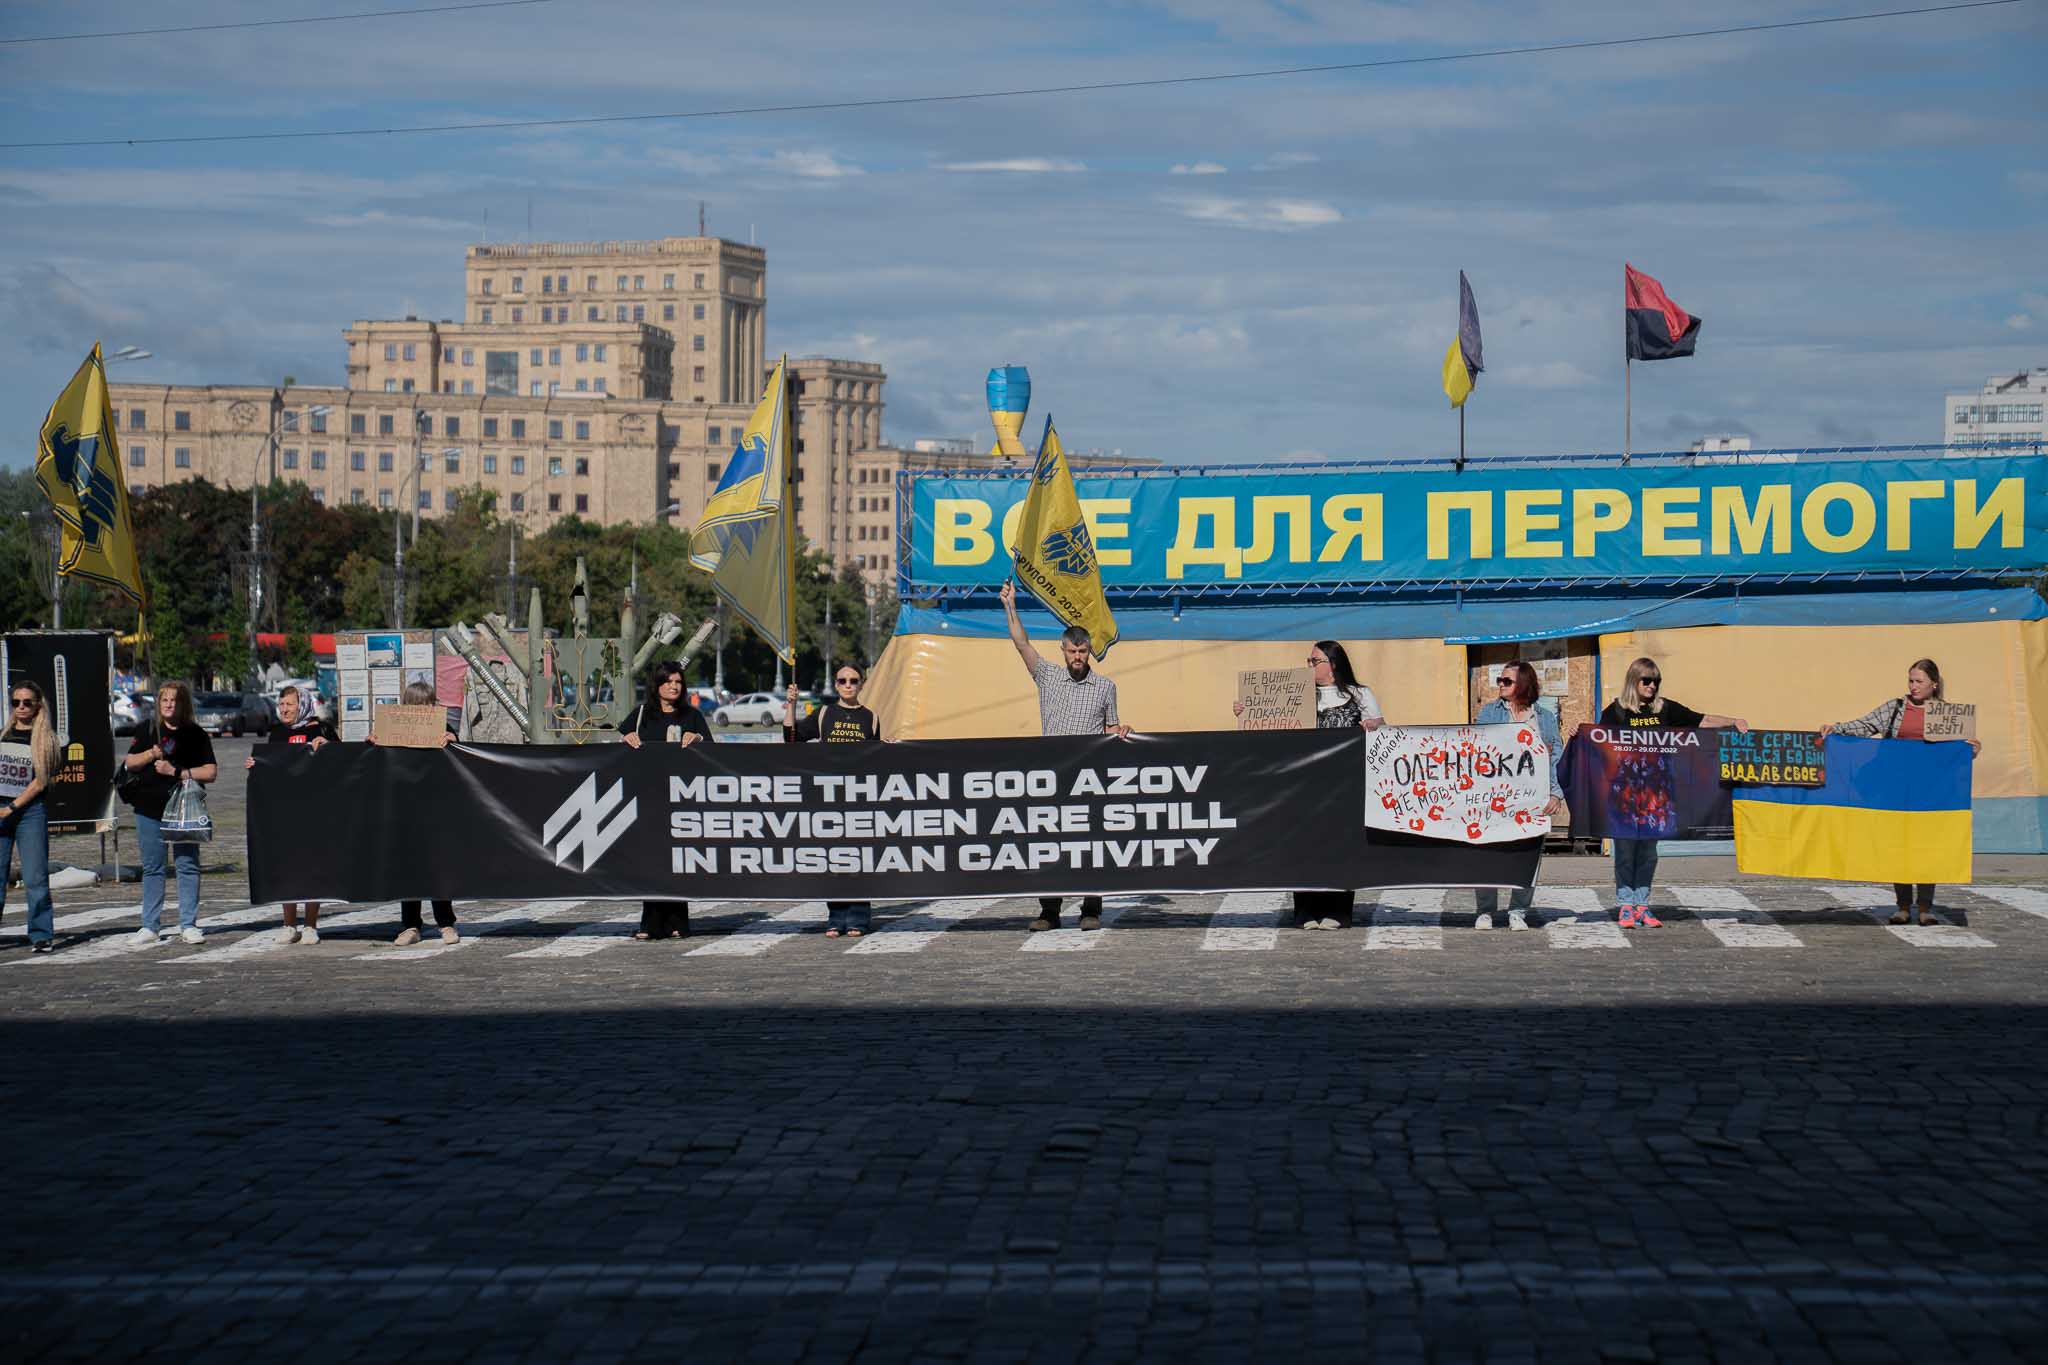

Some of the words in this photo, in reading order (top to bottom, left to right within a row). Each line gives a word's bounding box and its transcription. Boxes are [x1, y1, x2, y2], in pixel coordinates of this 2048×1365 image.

[1166, 493, 1384, 580] ДЛЯ
[1426, 476, 2025, 560] ПЕРЕМОГИ
[1017, 554, 1057, 597] РІУПОЛЬ
[1057, 596, 1082, 620] 2022
[1244, 672, 1257, 685] НЕ
[1248, 706, 1298, 720] ПОКАРАНІ
[1287, 695, 1302, 706] НЕ
[1590, 728, 1700, 747] OLENIVKA
[1943, 715, 1958, 724] НЕ
[669, 775, 802, 802] MORE
[813, 772, 950, 802] THAN
[963, 769, 1057, 799] 600
[1070, 765, 1208, 796] AZOV
[1394, 750, 1536, 787] ОЛЕНІВКА
[670, 807, 977, 839] SERVICEMEN
[989, 804, 1090, 834] ARE
[1103, 801, 1237, 831] STILL
[671, 847, 718, 874] IN
[730, 844, 946, 874] RUSSIAN
[958, 837, 1220, 872] CAPTIVITY
